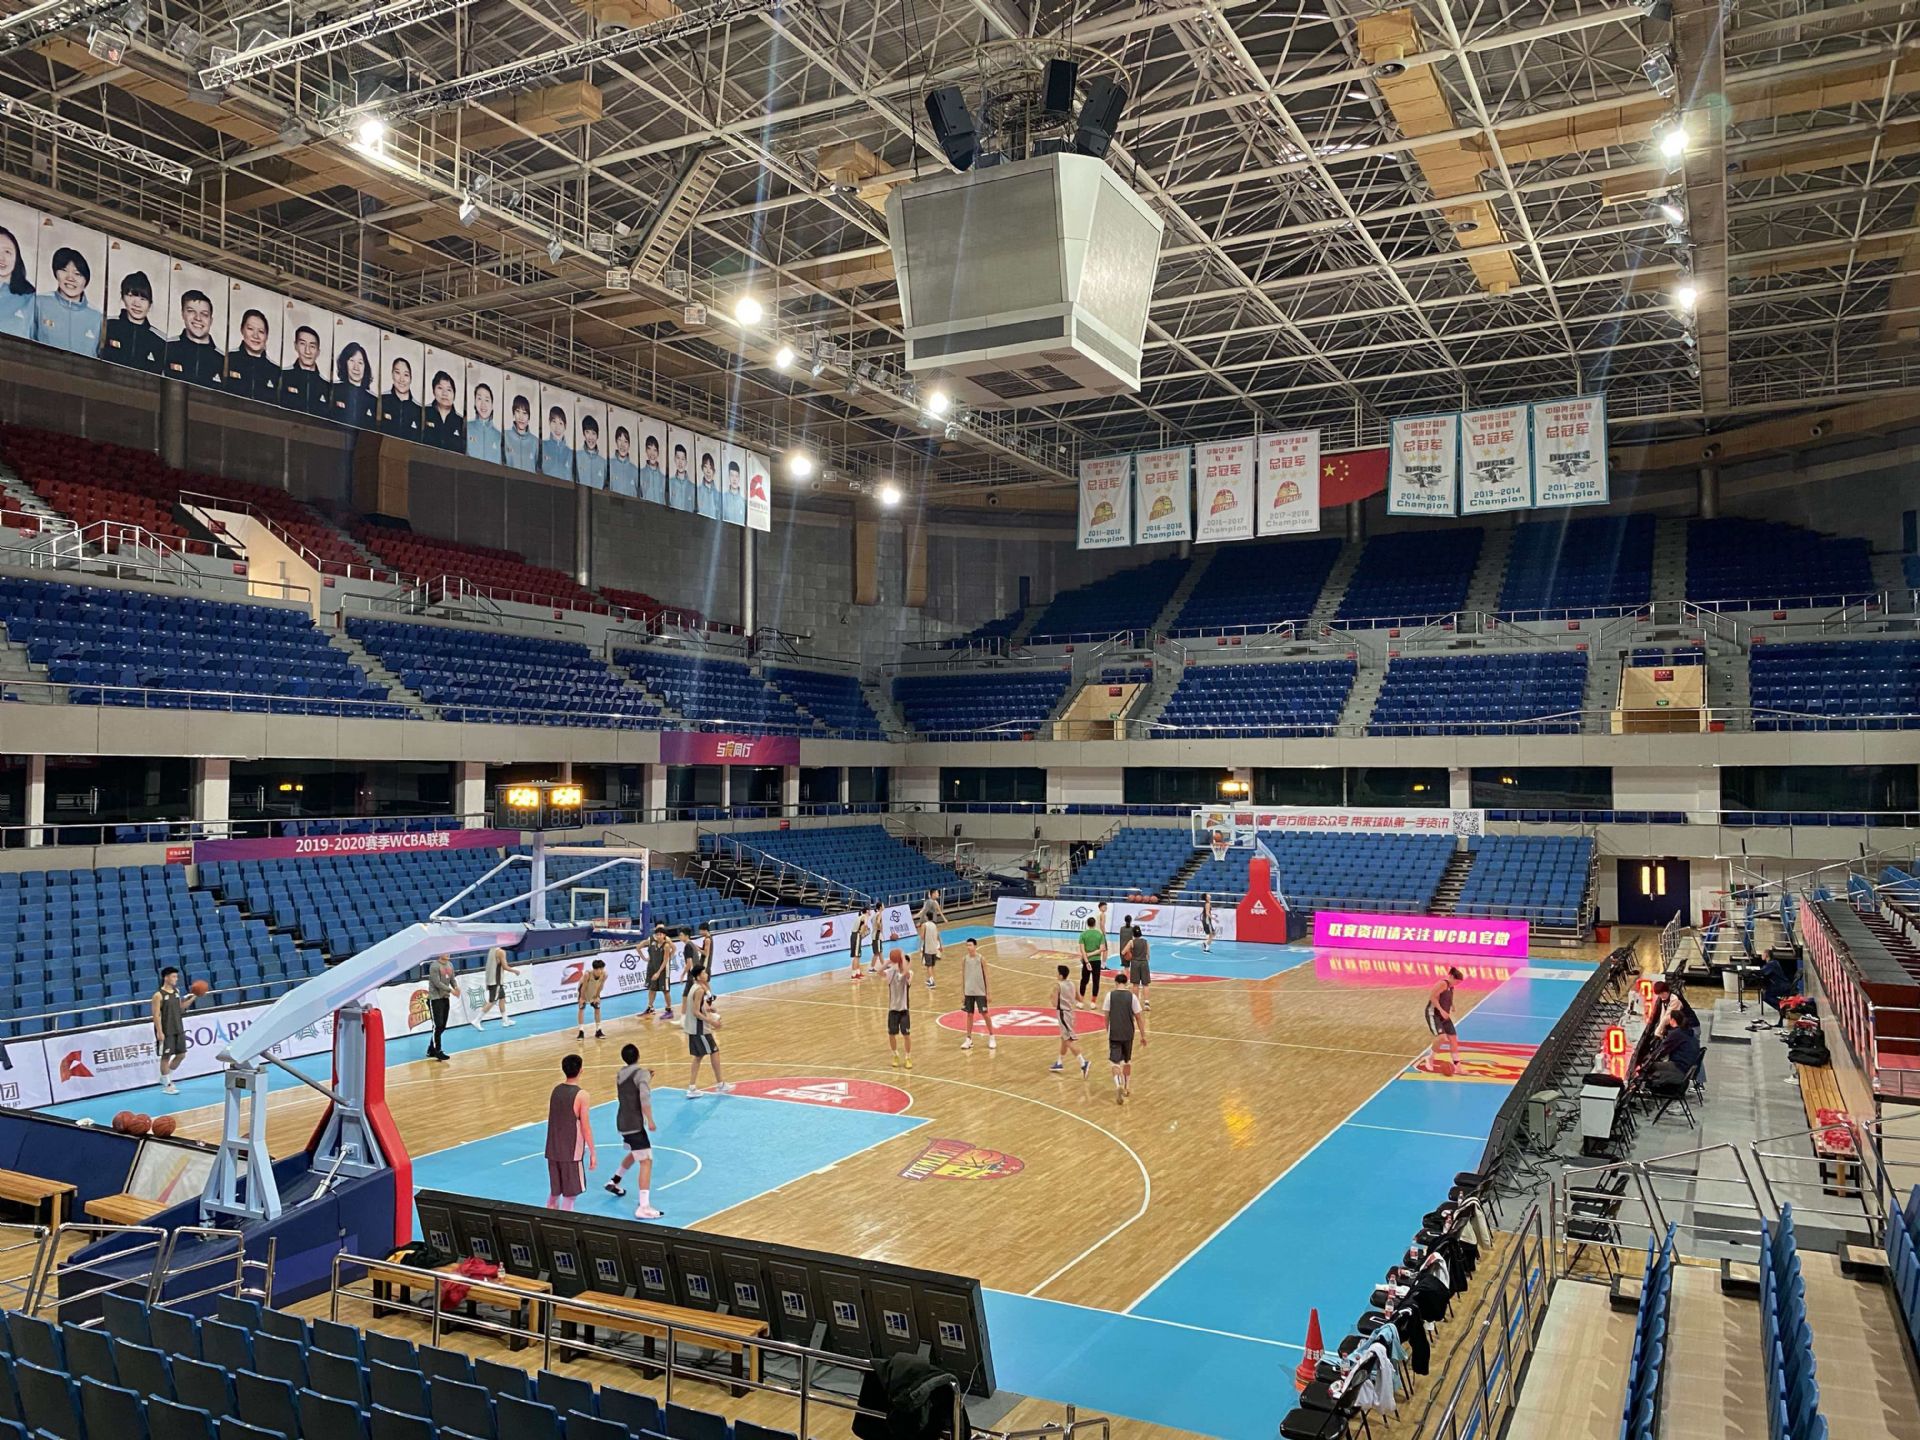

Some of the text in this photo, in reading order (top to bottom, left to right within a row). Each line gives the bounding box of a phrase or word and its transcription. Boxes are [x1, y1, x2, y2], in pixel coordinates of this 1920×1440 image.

[1546, 422, 1590, 439] 总冠军
[1472, 430, 1515, 446] 总冠军
[1403, 439, 1443, 452] 总冠军
[1269, 454, 1306, 470] 总冠军
[1476, 456, 1515, 470] DUCKS
[1549, 450, 1591, 462] DUCKS
[1206, 463, 1242, 478] 总冠军
[1404, 465, 1442, 473] DUCKS
[1087, 477, 1121, 491] 总冠军
[1144, 470, 1179, 485] 总冠军
[1469, 495, 1525, 507] Champion
[1542, 489, 1601, 501] Champion
[1396, 500, 1449, 510] Champion
[1202, 525, 1248, 534] Champion
[1265, 518, 1313, 528] Champion
[1083, 535, 1125, 544] Champion
[1141, 530, 1186, 540] Champion
[1276, 814, 1348, 828] 官方微信公众号
[1350, 816, 1450, 829] 带来球队第一手资讯
[295, 833, 450, 854] 2019-2020赛季WCBA联赛
[762, 929, 803, 947] SOARING
[723, 955, 758, 971] 首钢地产
[1609, 1029, 1625, 1053] 0
